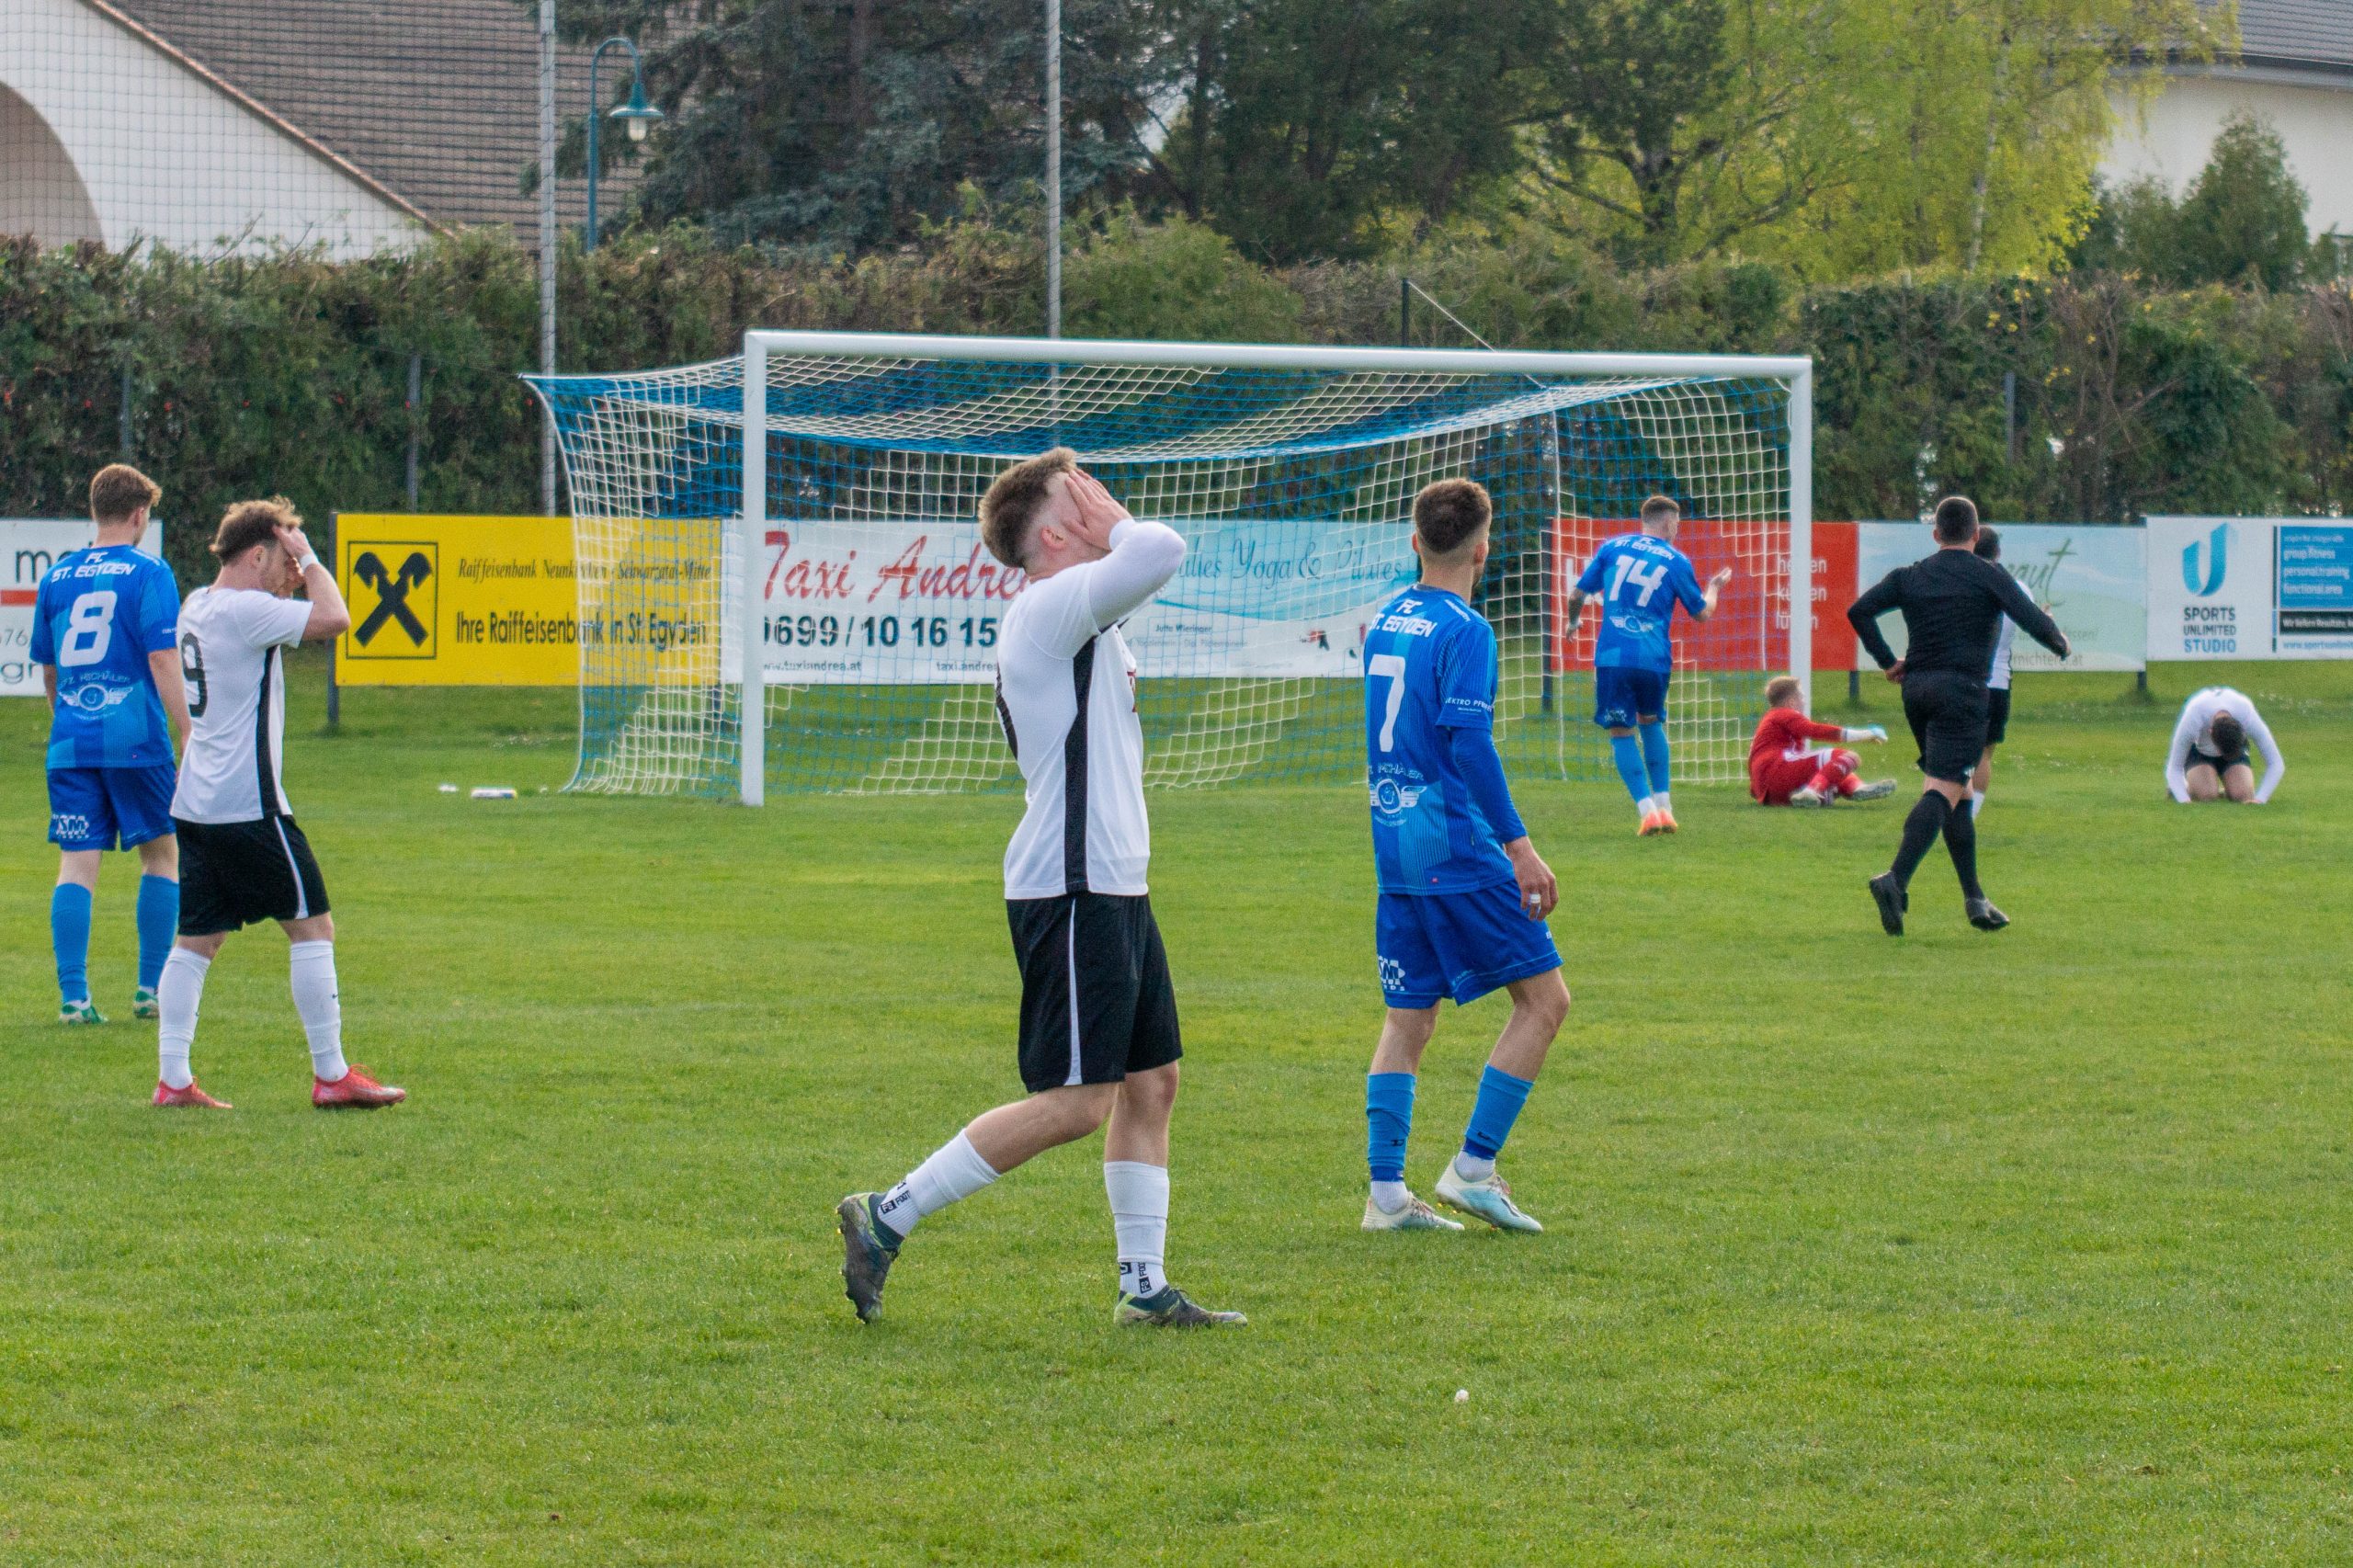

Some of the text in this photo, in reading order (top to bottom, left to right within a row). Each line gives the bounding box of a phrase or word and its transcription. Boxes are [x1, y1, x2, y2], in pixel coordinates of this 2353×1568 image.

[85, 551, 108, 563] FC
[459, 558, 537, 584] Raiffeisenbank
[765, 530, 857, 600] Taxi
[1233, 538, 1295, 589] Yoga
[51, 562, 136, 584] ST. EGYDEN
[1608, 554, 1668, 608] 14
[1396, 598, 1424, 614] FC
[2184, 607, 2235, 621] SPORTS
[60, 590, 118, 667] 8
[456, 610, 484, 643] Ihre
[490, 610, 604, 643] Raiffeisenbank
[649, 611, 706, 652] Egyden
[911, 617, 949, 647] 16
[960, 617, 998, 647] 15
[1382, 615, 1438, 638] EGYDEN
[2183, 624, 2236, 636] UNLIMITED
[2184, 638, 2236, 653] STUDIO
[181, 631, 209, 718] 9
[1368, 653, 1405, 752] 7
